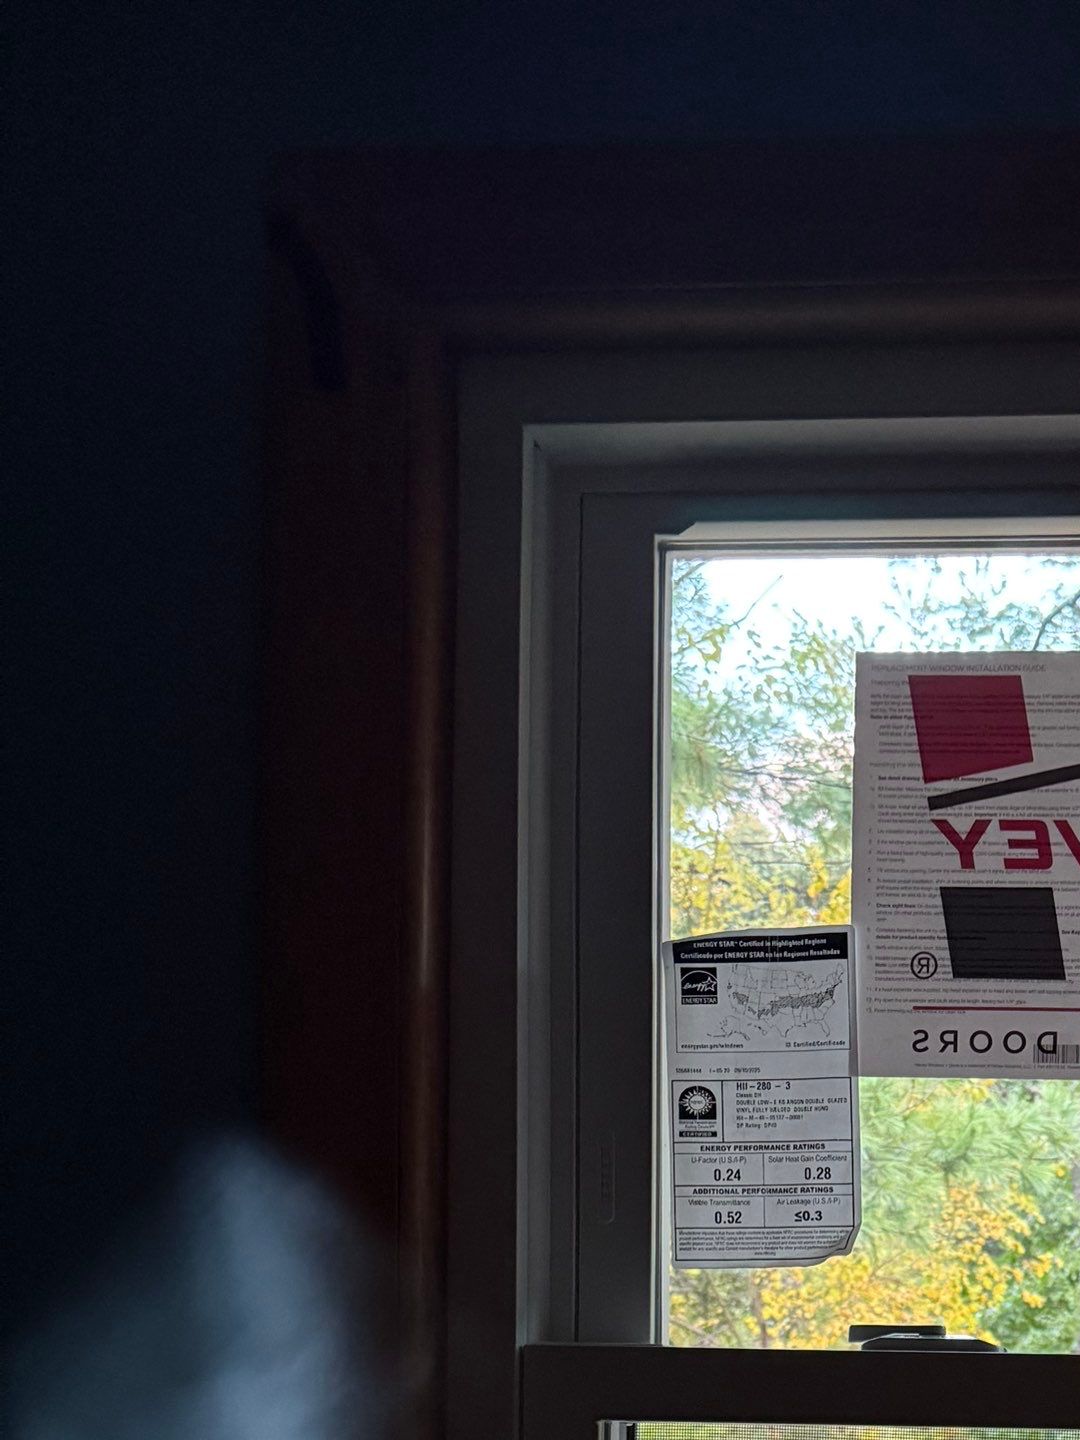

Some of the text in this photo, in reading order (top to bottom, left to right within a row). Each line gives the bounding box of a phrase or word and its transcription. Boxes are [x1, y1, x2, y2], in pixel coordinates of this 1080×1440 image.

[738, 940, 765, 948] Certified
[724, 951, 749, 959] ENERGY
[749, 951, 765, 959] STAR
[733, 1144, 791, 1152] PERFORMANCE
[768, 1155, 784, 1163] Solar
[713, 1168, 742, 1182] 0.24
[804, 1166, 832, 1180] 0.28
[692, 1186, 834, 1195] ADDITIONAL PERFORMANCE RATINGS
[714, 1211, 742, 1224] 0.52
